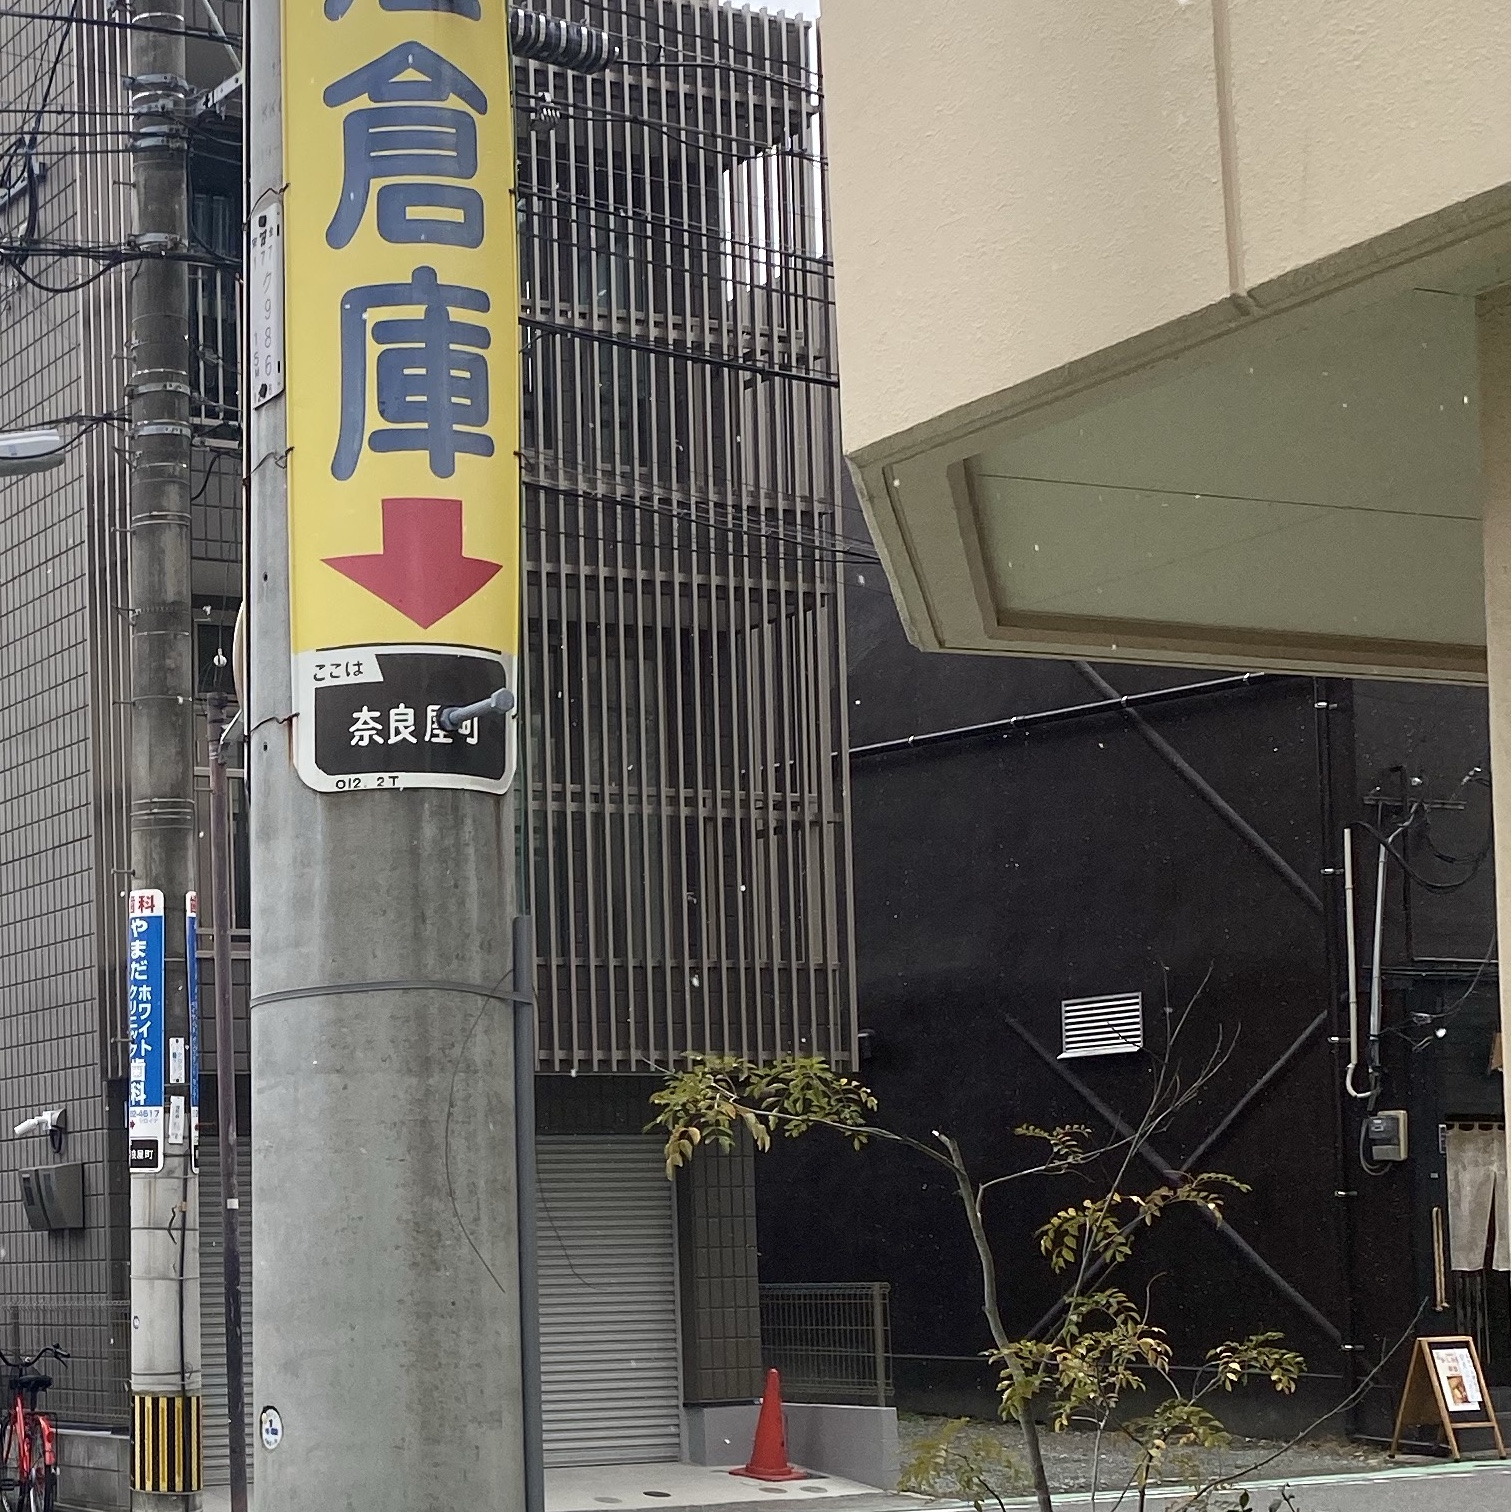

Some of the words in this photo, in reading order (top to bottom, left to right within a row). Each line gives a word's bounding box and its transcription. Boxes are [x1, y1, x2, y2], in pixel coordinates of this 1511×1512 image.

[323, 0, 496, 481] 倉庫
[313, 660, 364, 682] ここは
[130, 918, 149, 981] やまだ
[138, 984, 153, 1057] ホワイト
[130, 1057, 147, 1106] 歯科
